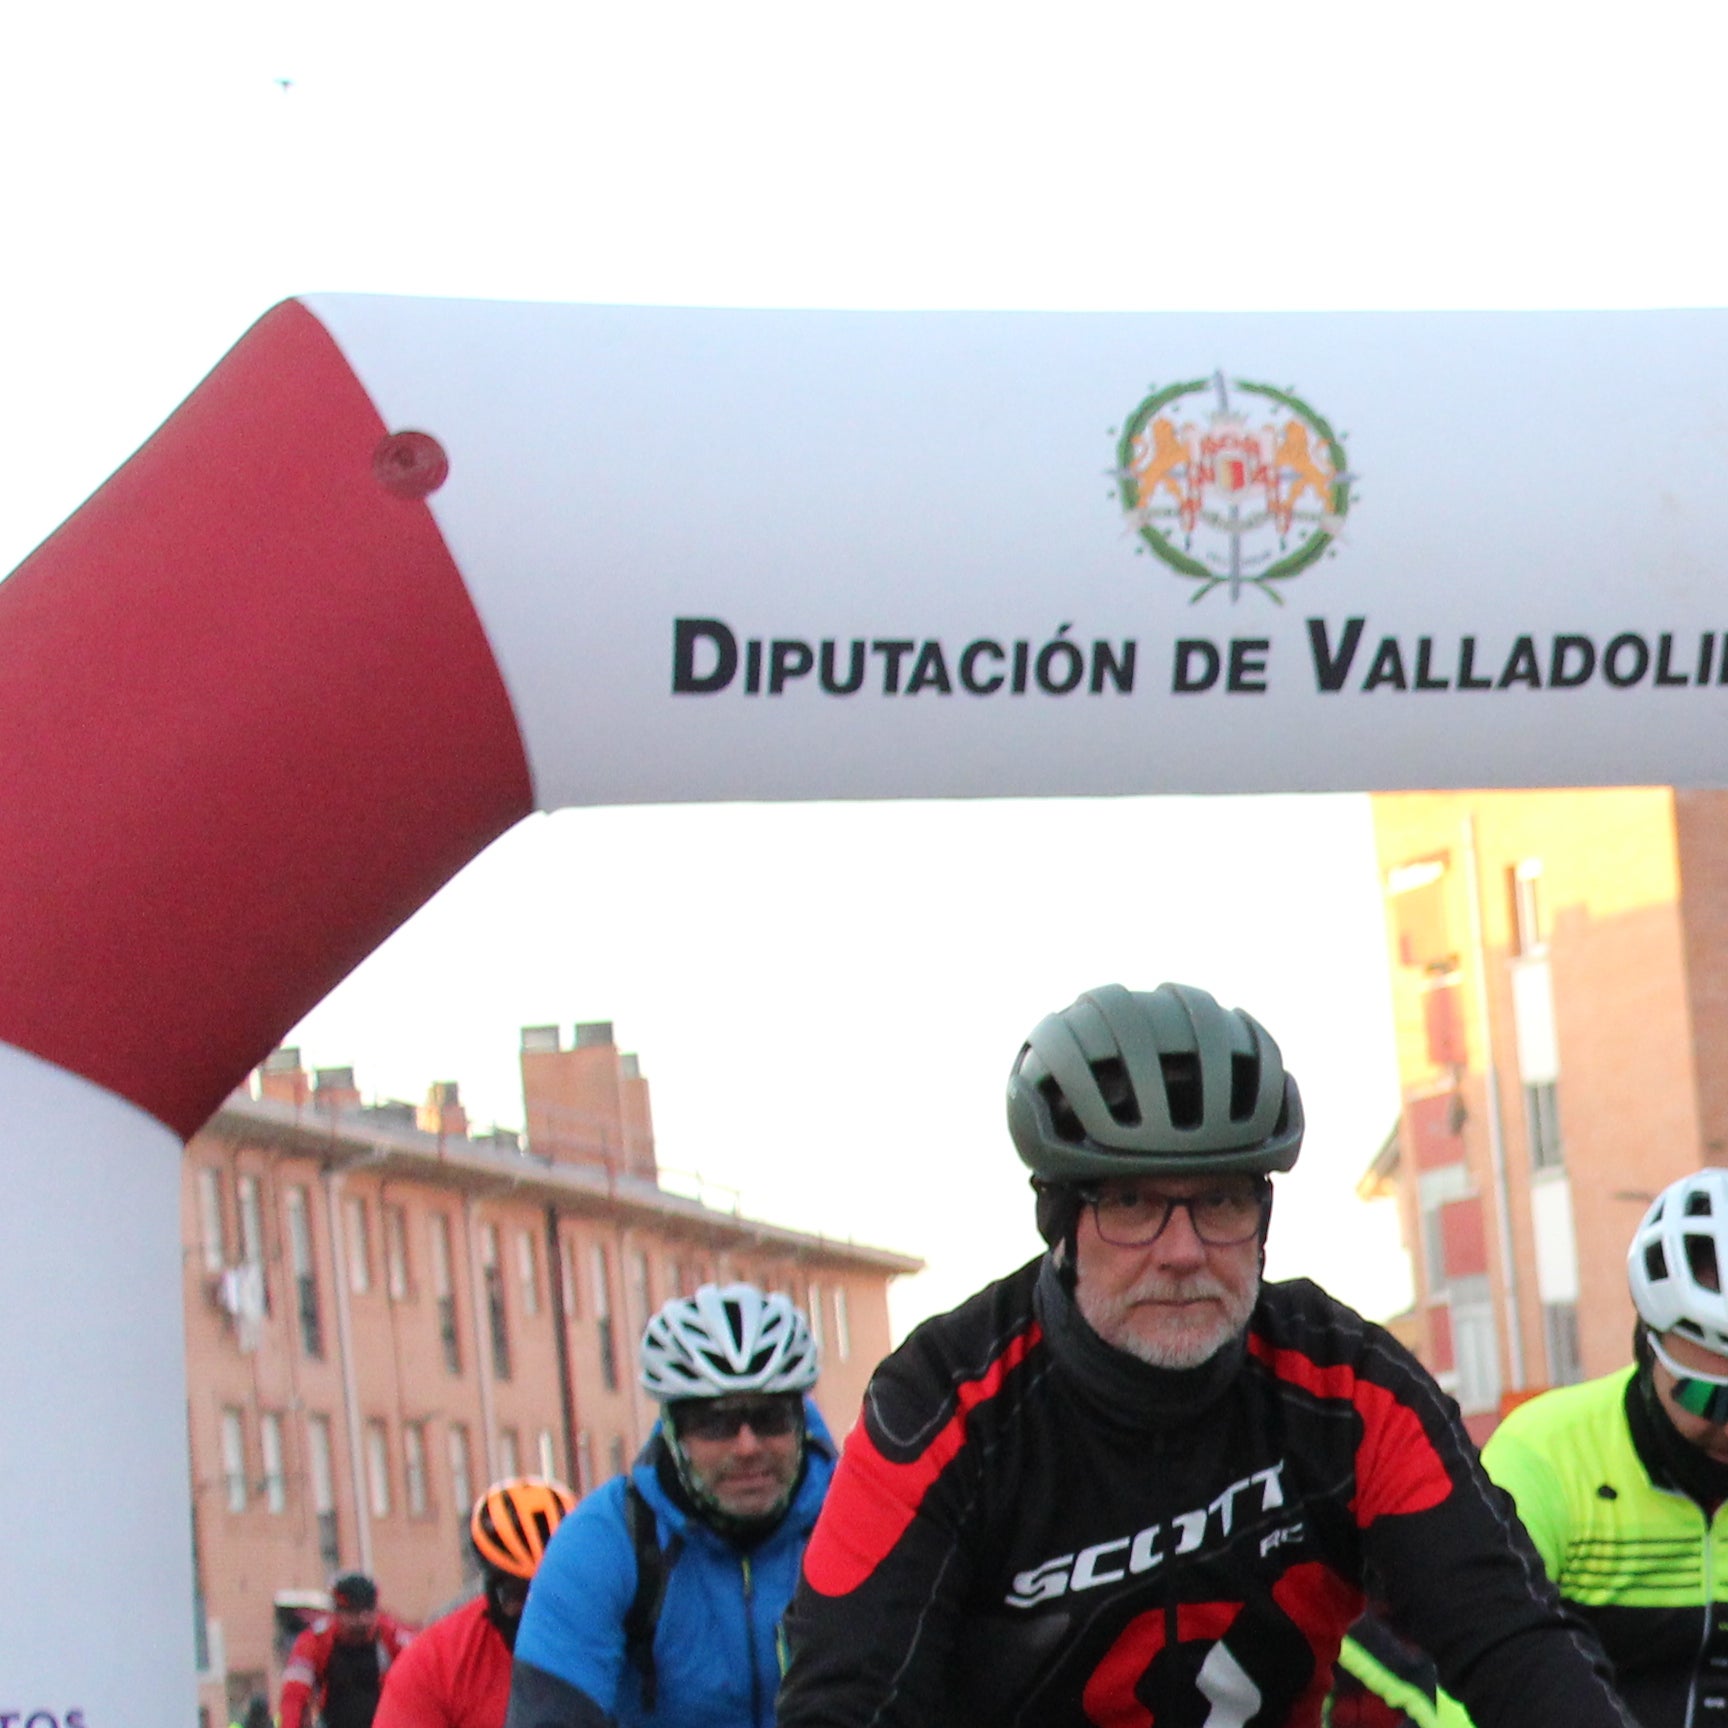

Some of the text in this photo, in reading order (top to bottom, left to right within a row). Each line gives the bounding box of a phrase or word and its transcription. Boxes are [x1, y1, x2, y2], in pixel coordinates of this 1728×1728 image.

[671, 617, 1135, 697] DIPUTACIÓN
[1171, 639, 1270, 694] DE
[1005, 1459, 1286, 1608] SCOTT
